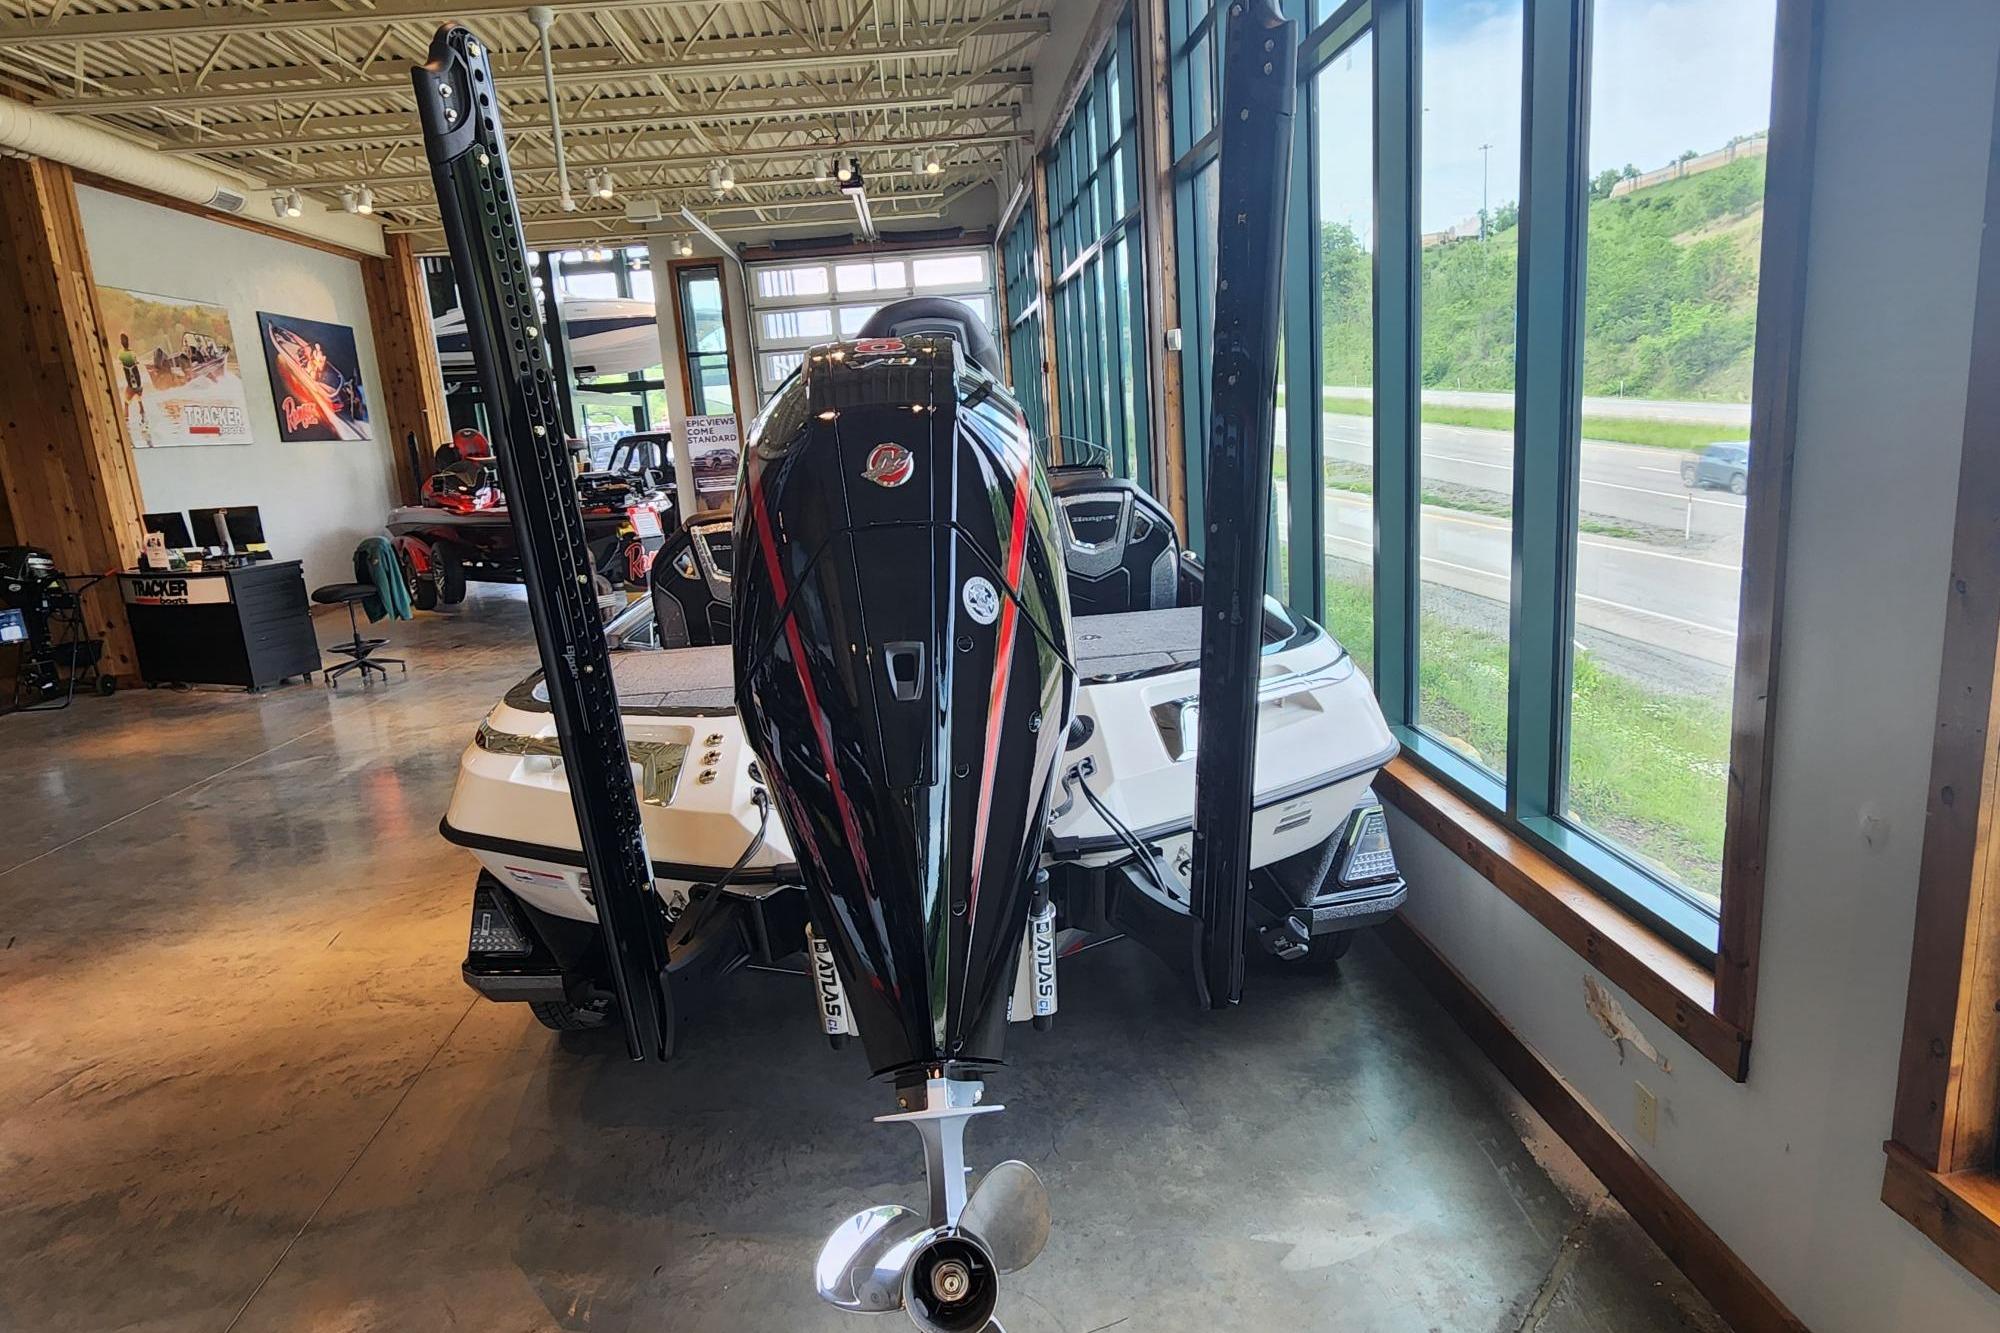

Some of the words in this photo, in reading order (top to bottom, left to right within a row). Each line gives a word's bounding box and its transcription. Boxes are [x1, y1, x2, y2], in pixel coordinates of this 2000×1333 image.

[184, 405, 241, 426] TRACKER
[686, 419, 705, 427] EPIC
[706, 417, 735, 426] VIEWS
[687, 427, 714, 435] COME
[688, 434, 737, 444] STANDARD
[132, 580, 188, 597] TRACKER
[1036, 937, 1053, 997] ATLAS
[816, 955, 842, 1017] ATLAS
